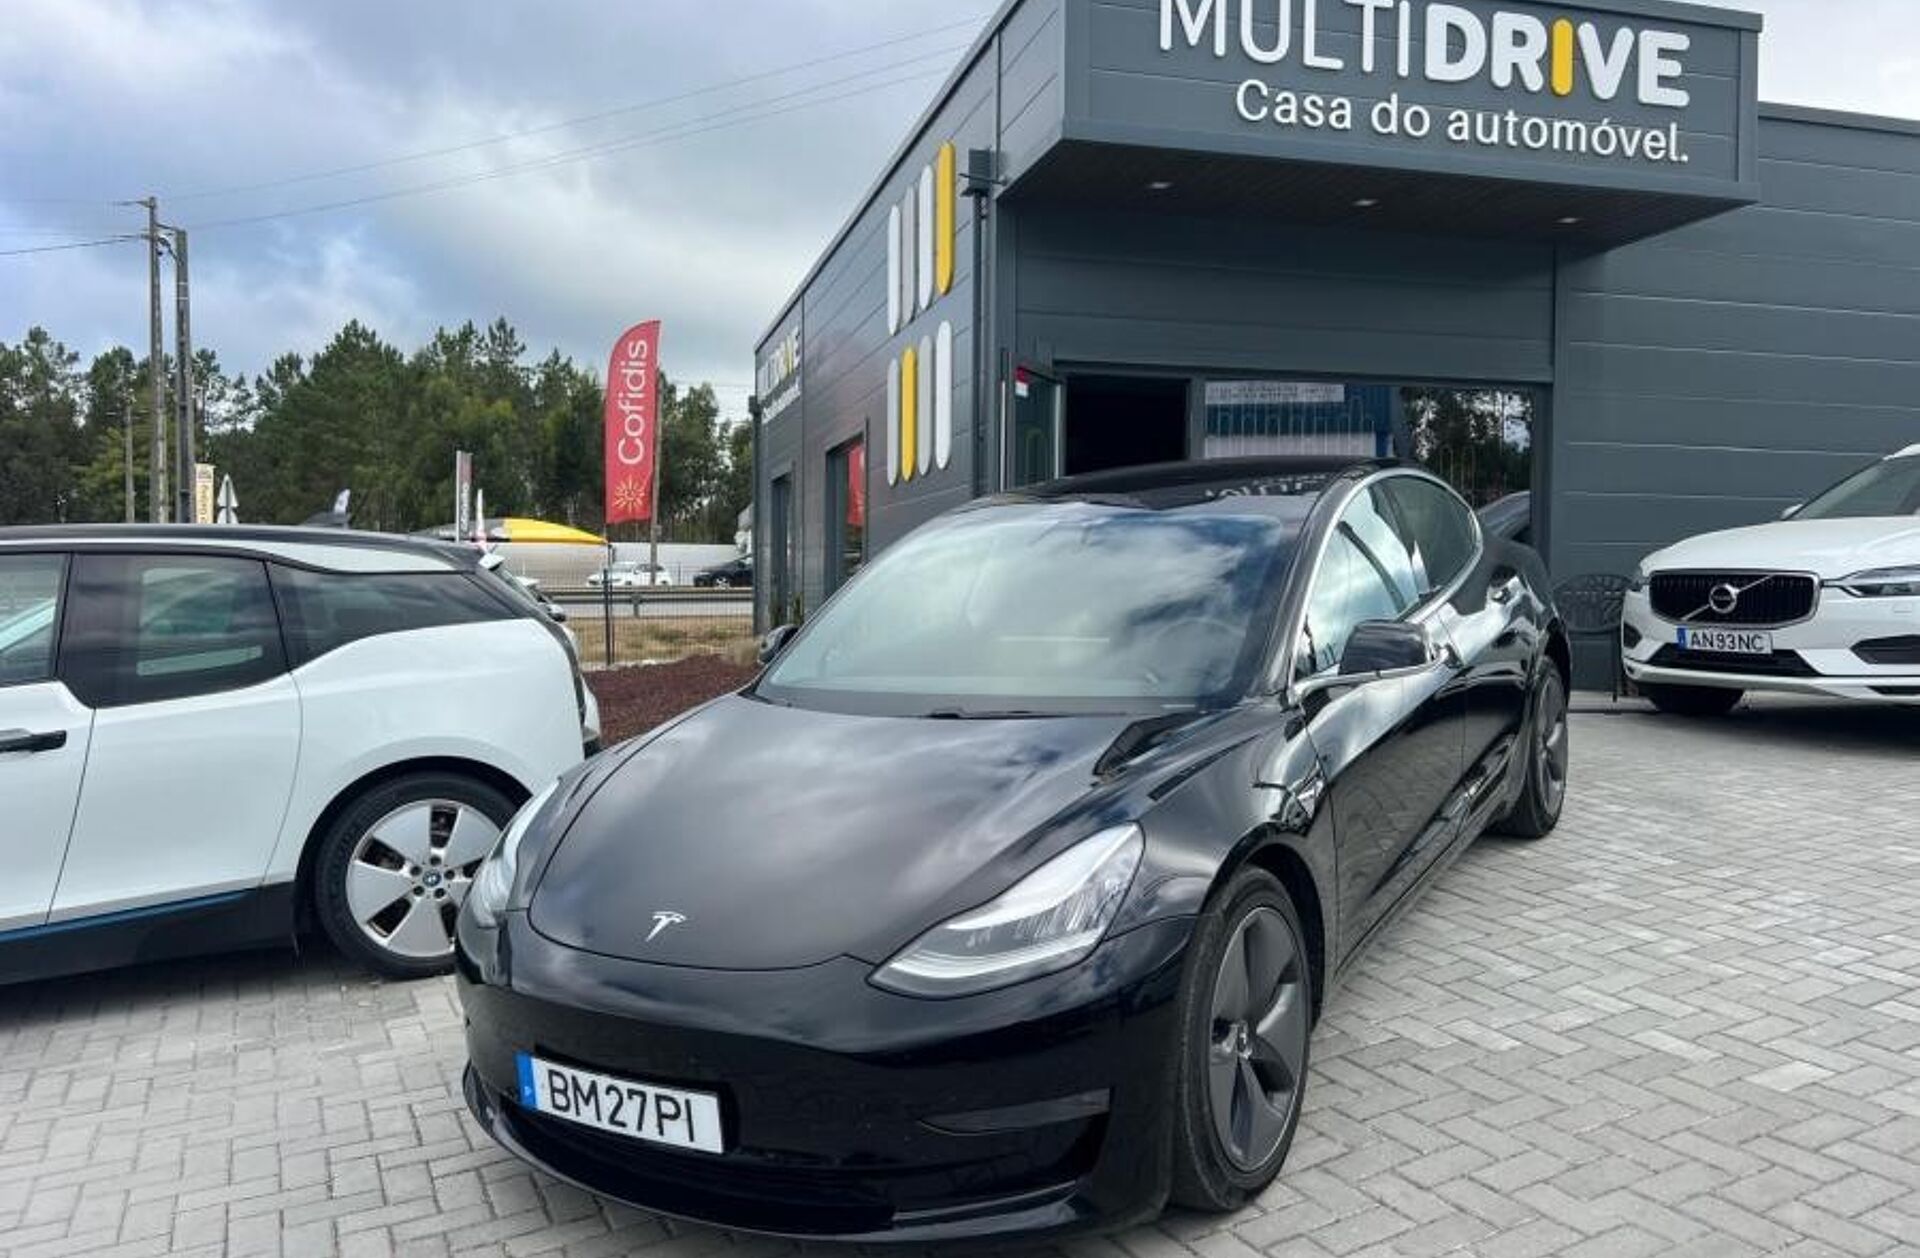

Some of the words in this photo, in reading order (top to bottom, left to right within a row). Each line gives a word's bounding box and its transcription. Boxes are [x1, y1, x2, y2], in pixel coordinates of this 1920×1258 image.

[1160, 0, 1691, 107] MULTIDRIVE
[1236, 79, 1352, 129] Casa
[1371, 93, 1432, 138] do
[1448, 107, 1690, 163] automóvel.
[618, 340, 647, 464] Cofidis
[1691, 630, 1764, 651] AN93NC
[548, 1069, 694, 1143] BM27PI
